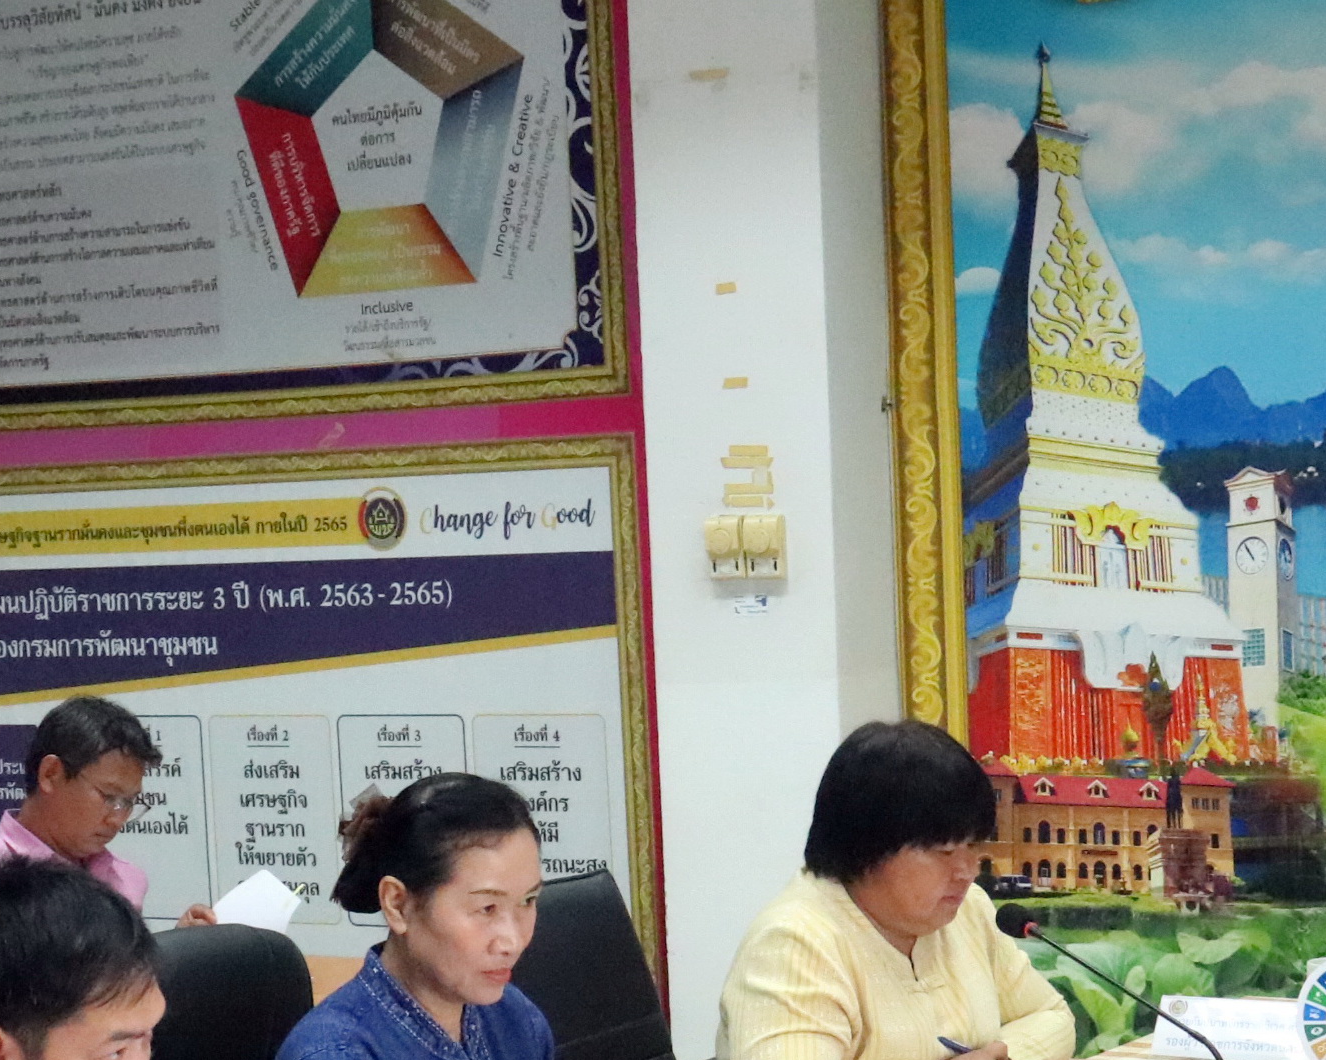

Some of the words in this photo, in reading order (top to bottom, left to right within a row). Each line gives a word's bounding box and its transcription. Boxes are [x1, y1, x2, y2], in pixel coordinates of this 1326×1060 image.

[331, 101, 423, 127] คนไทยมีภูมิคุ้มกัน
[360, 131, 396, 146] ต่อการ
[347, 154, 412, 171] เปลี่ยนแปลง
[492, 177, 518, 258] Innovative
[511, 92, 534, 157] Creative
[236, 149, 255, 188] Good
[246, 191, 278, 271] governance
[360, 300, 414, 315] Inclusive
[255, 511, 307, 535] ภายในปี
[313, 515, 348, 532] 2565
[419, 503, 499, 540] Change
[503, 501, 536, 540] for
[541, 498, 596, 531] Good
[213, 587, 226, 609] 3
[232, 580, 251, 609] ปี
[259, 583, 312, 614] (พ.ศ.
[246, 722, 280, 743] เรื่องที่
[282, 730, 290, 742] 2
[376, 724, 410, 743] เรื่องที่
[414, 729, 422, 742] 3
[513, 724, 548, 743] เรื่องที่
[552, 729, 560, 742] 4
[243, 760, 301, 780] ส่งเสริม
[500, 760, 582, 782] เสริมสร้าง
[239, 789, 309, 815] เศรษฐกิจ
[244, 822, 306, 844] ฐานราก
[236, 843, 318, 868] ให้ขยายตัว
